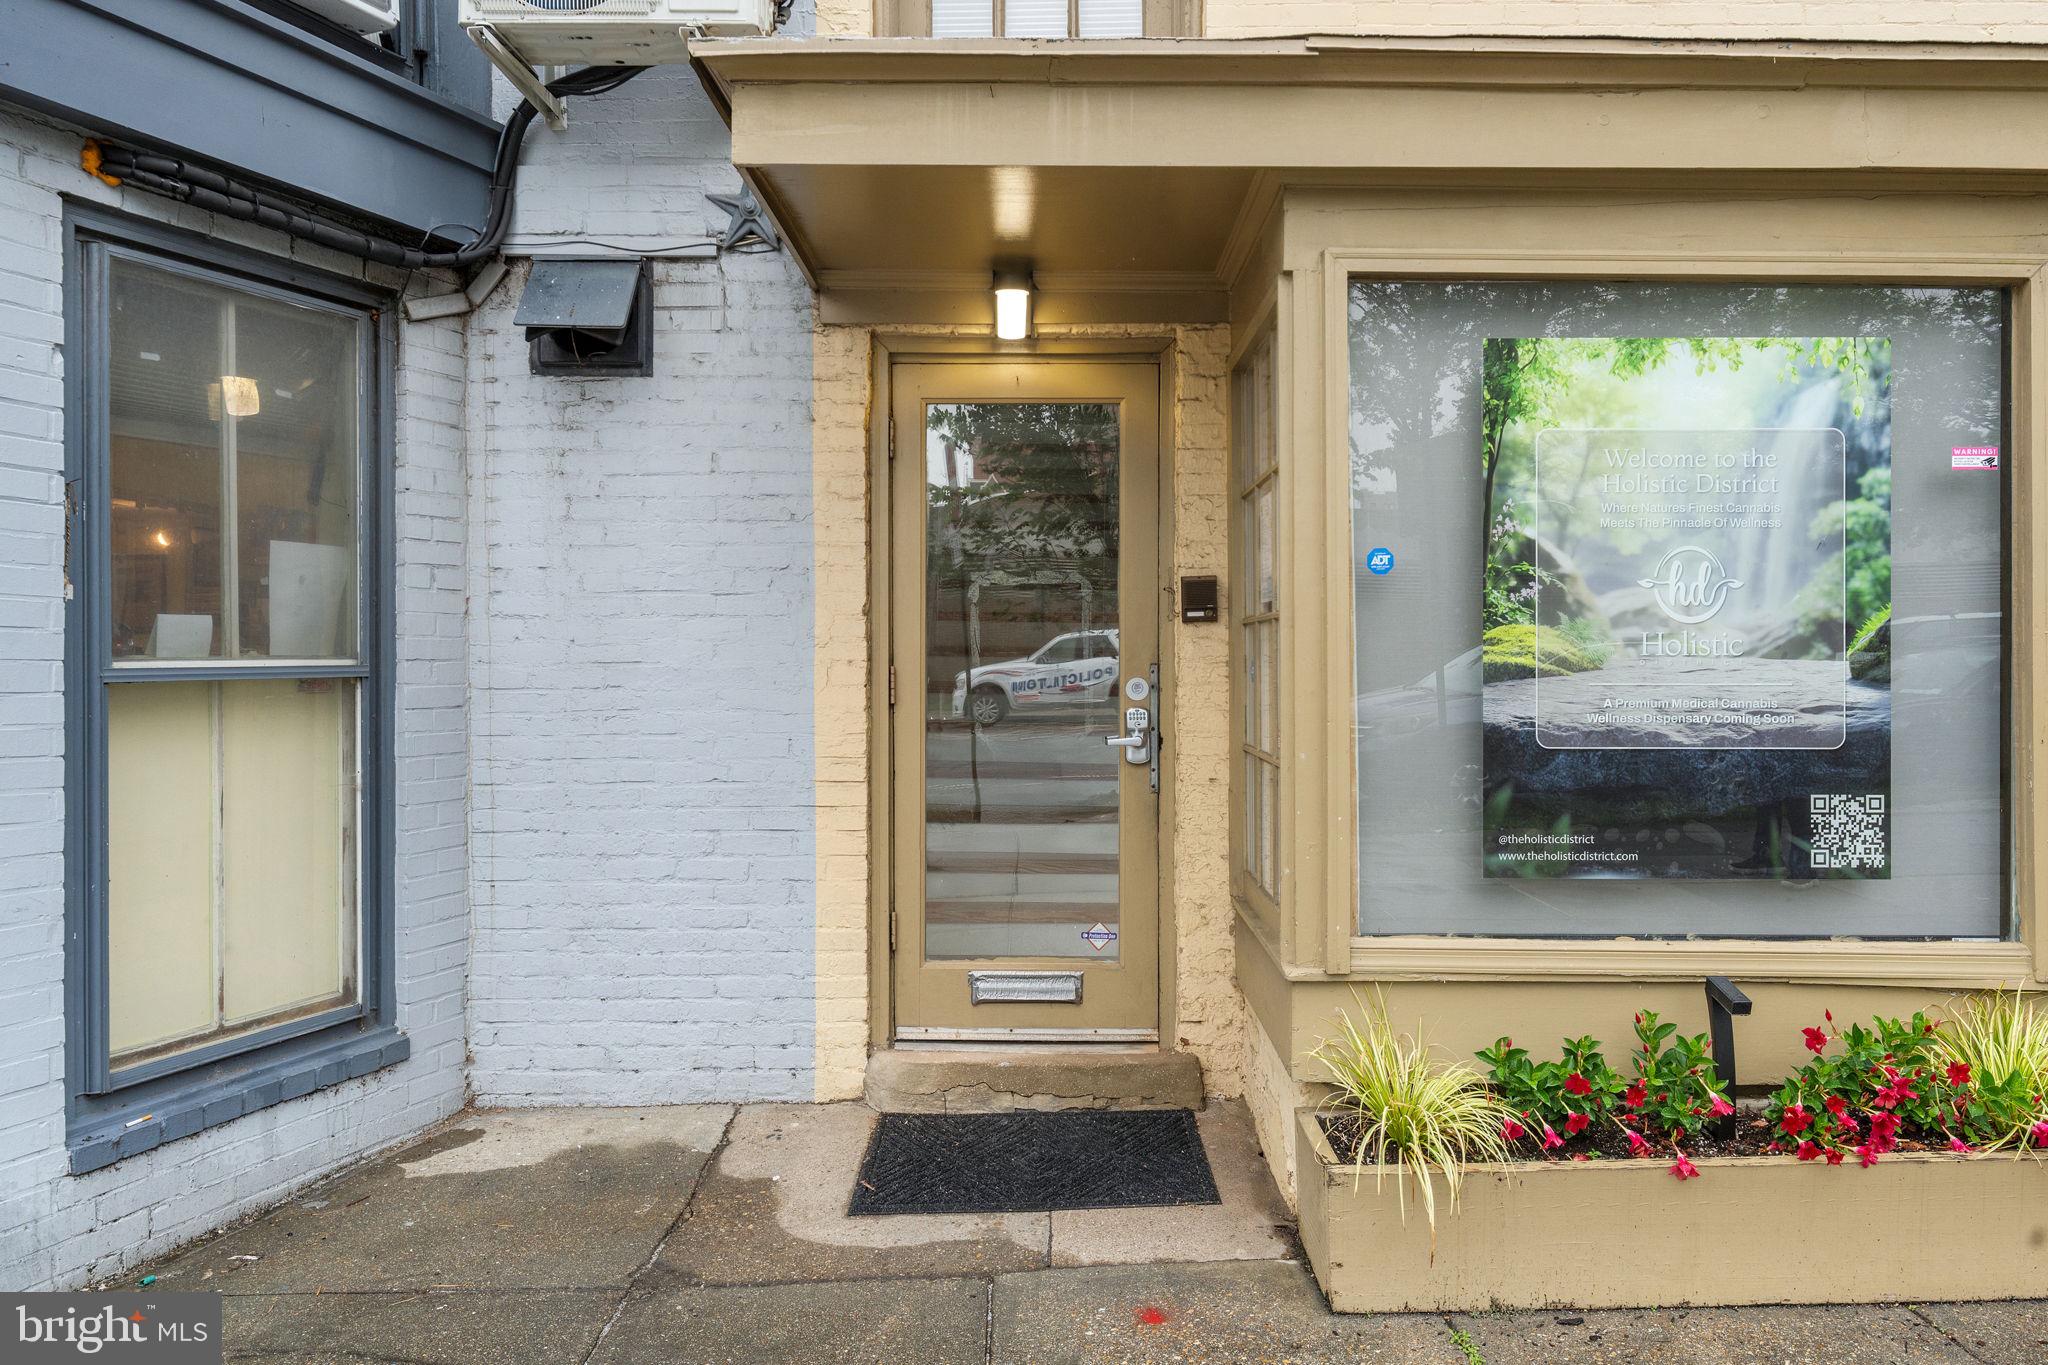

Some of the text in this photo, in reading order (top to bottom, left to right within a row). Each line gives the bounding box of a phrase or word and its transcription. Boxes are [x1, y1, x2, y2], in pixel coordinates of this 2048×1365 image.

[1604, 448, 1778, 468] Welcome to the
[1601, 473, 1780, 493] Holistic District
[1602, 503, 1781, 513] Where Natures Finest Cannabis
[1600, 518, 1782, 528] Meets The Pinnacle Of Wellness
[1371, 555, 1390, 565] ADT
[1668, 560, 1714, 607] hd
[1640, 630, 1744, 657] Holistic
[1603, 699, 1778, 709] A Premium Medical Cannabis
[1587, 713, 1795, 726] Wellness Dispensary Coming Soon
[1498, 834, 1595, 845] @theholisticdistrict
[1498, 850, 1639, 861] www.theholisticdistrict.com
